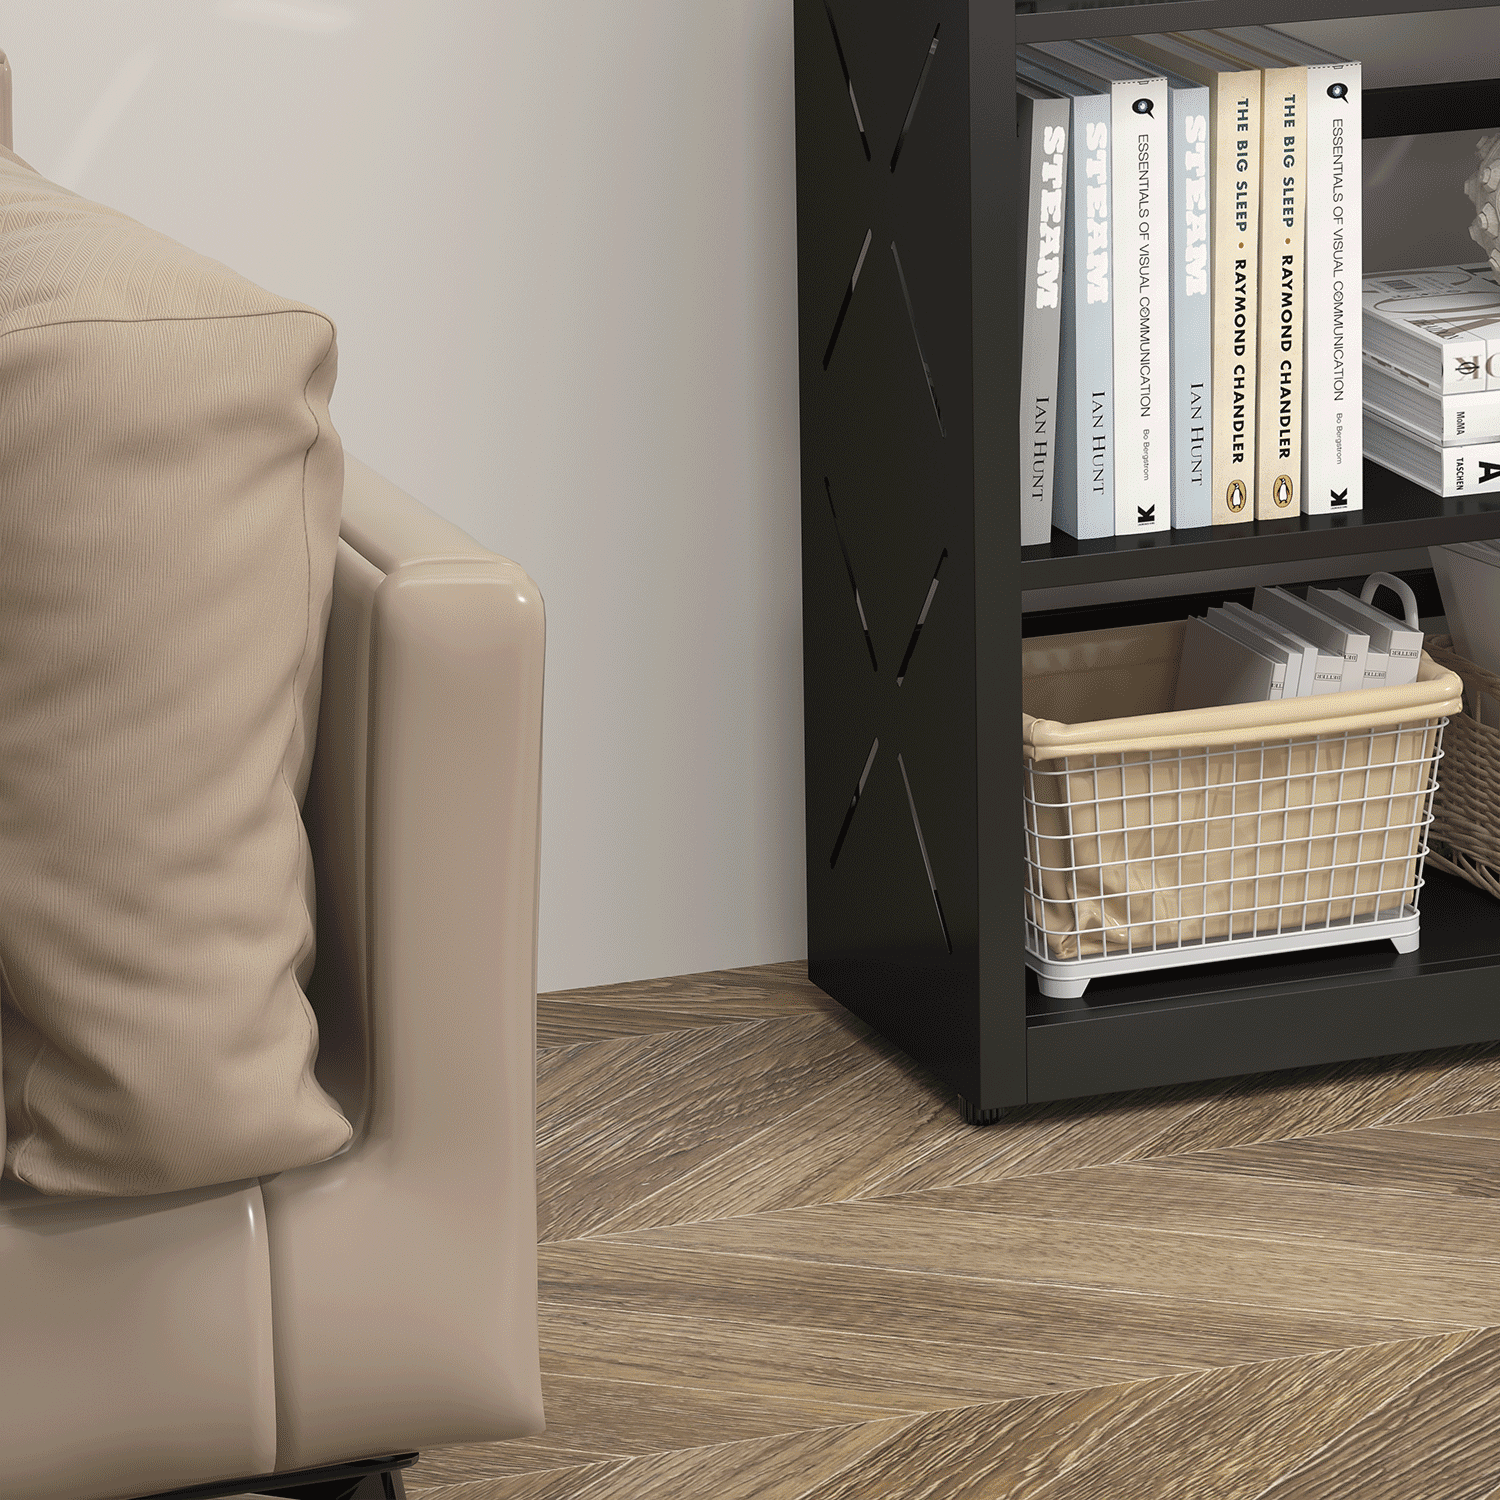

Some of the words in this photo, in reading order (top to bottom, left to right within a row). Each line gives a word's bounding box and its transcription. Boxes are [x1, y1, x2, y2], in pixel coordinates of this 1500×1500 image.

[1236, 97, 1249, 132] THE
[1284, 94, 1296, 128] THE
[1138, 133, 1150, 219] ESSENTIALS
[1236, 140, 1248, 173] BIG
[1283, 136, 1295, 168] BIG
[1332, 118, 1344, 203] ESSENTIALS
[1036, 125, 1065, 309] STEAM
[1085, 121, 1109, 304] STEAM
[1184, 114, 1207, 297] STEAM
[1235, 181, 1248, 232] SLEEP
[1282, 177, 1295, 228] SLEEP
[1332, 205, 1344, 226] OF
[1138, 221, 1150, 242] OF
[1332, 227, 1344, 278] VISUAL
[1138, 243, 1150, 294] VISUAL
[1233, 259, 1247, 357] RAYMOND
[1281, 254, 1294, 352] RAYMOND
[1139, 296, 1151, 418] COMMUNICATION
[1332, 280, 1345, 401] COMMUNICATION
[1034, 396, 1050, 434] IAN
[1092, 391, 1106, 429] IAN
[1190, 382, 1204, 420] IAN
[1232, 364, 1246, 464] CHANDLER
[1279, 360, 1292, 460] CHANDLER
[1336, 412, 1343, 424] Bo
[1456, 411, 1465, 435] MoMA
[1143, 428, 1150, 441] Bo
[1190, 426, 1204, 486] HUNT
[1031, 440, 1048, 501] HUNT
[1092, 435, 1106, 495] HUNT
[1456, 457, 1464, 490] TASCHEN
